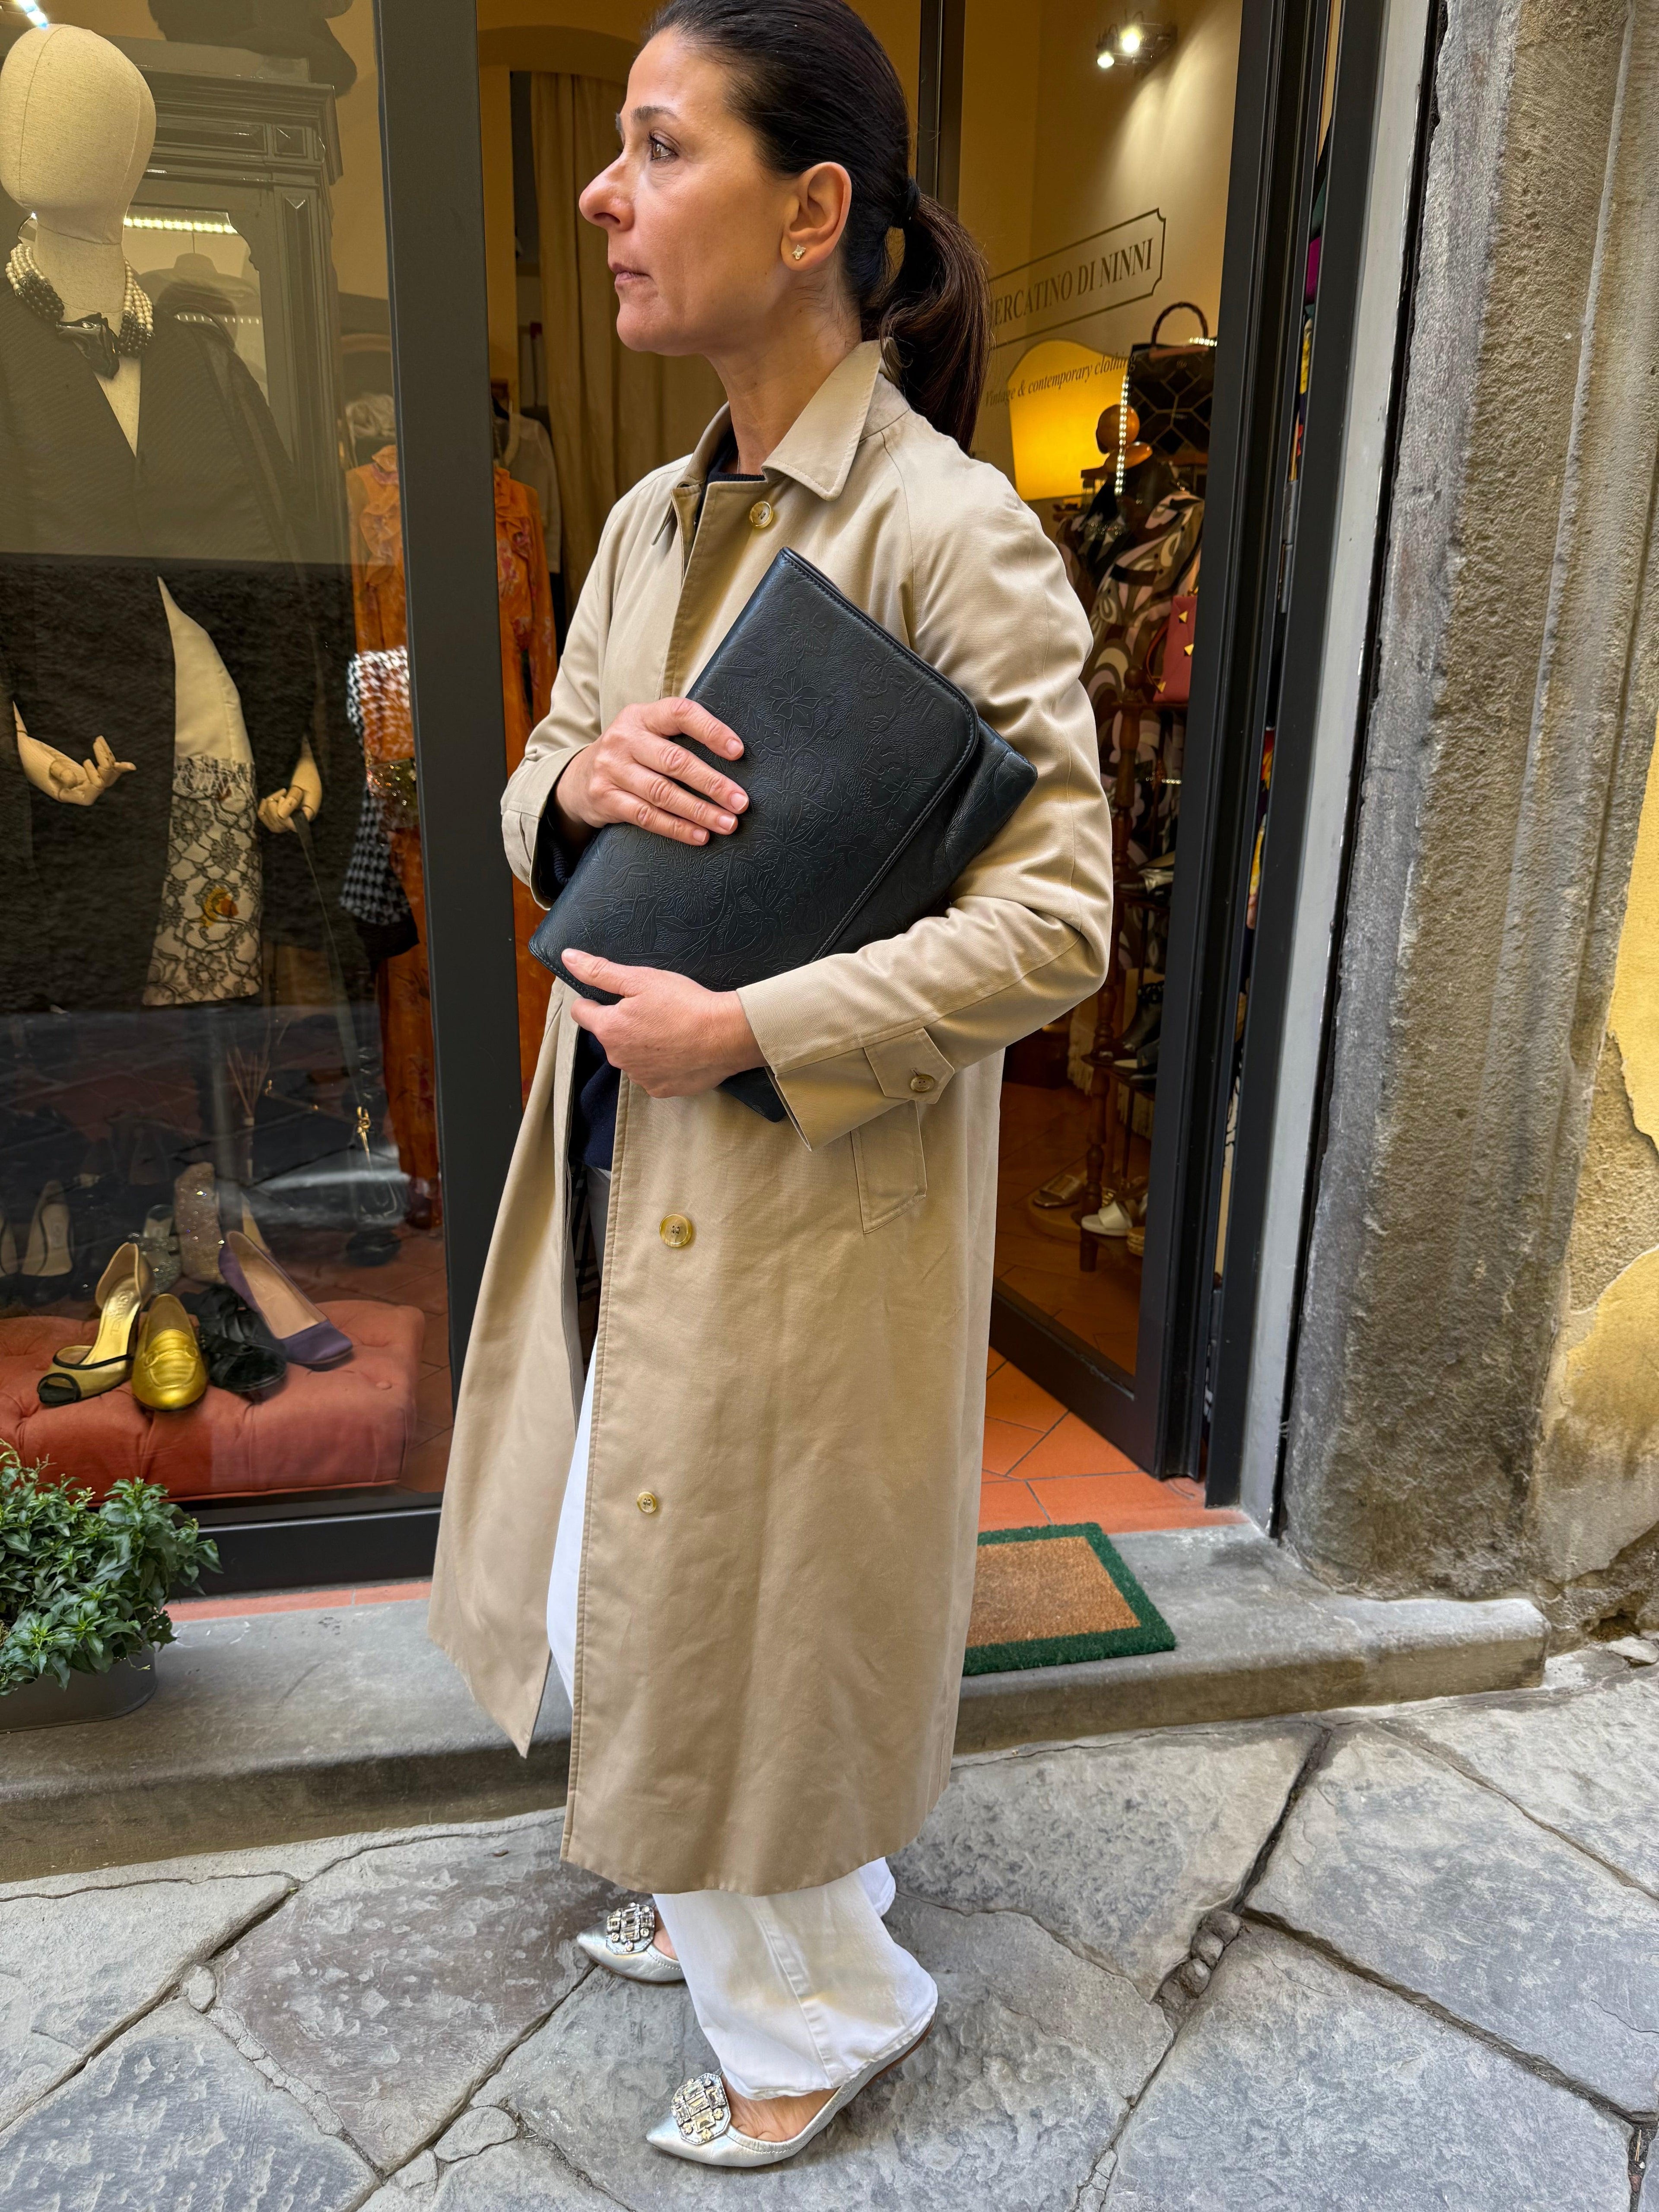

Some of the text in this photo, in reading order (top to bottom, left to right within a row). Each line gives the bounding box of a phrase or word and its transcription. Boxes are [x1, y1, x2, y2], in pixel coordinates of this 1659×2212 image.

[990, 238, 1154, 326] ERCATINO DI NINNI
[985, 388, 1016, 407] Vintage
[1017, 379, 1026, 397] &
[1028, 364, 1093, 394] contemporary
